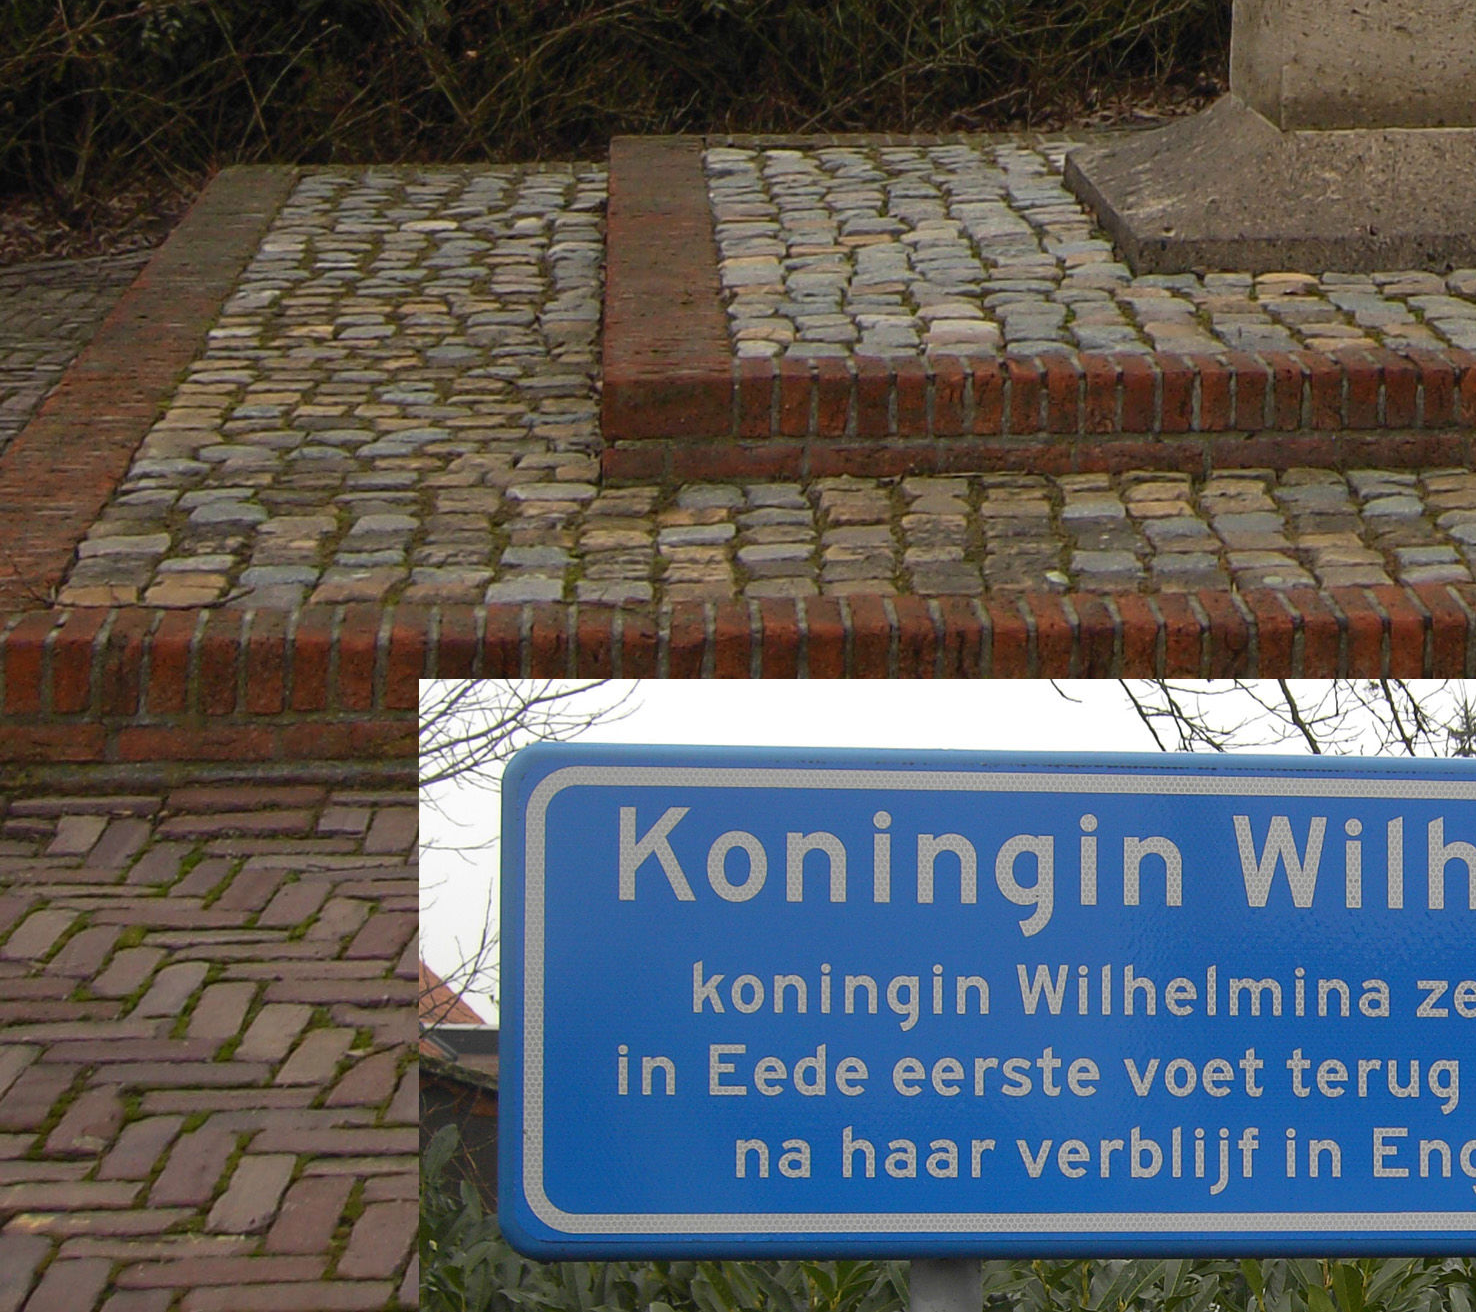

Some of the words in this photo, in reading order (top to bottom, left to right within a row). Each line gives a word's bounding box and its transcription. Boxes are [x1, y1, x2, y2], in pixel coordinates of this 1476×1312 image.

[619, 807, 1182, 936] Koningin
[693, 961, 989, 1031] koningin
[1017, 964, 1389, 1017] Wilhelmina
[618, 1045, 675, 1095] in
[709, 1044, 868, 1095] Eede
[893, 1047, 1099, 1096] eerste
[1124, 1049, 1263, 1097] voet
[1287, 1049, 1459, 1114] terug
[736, 1139, 810, 1177] na
[843, 1126, 995, 1177] haar
[1017, 1127, 1258, 1194] verblijf
[1286, 1128, 1341, 1177] in
